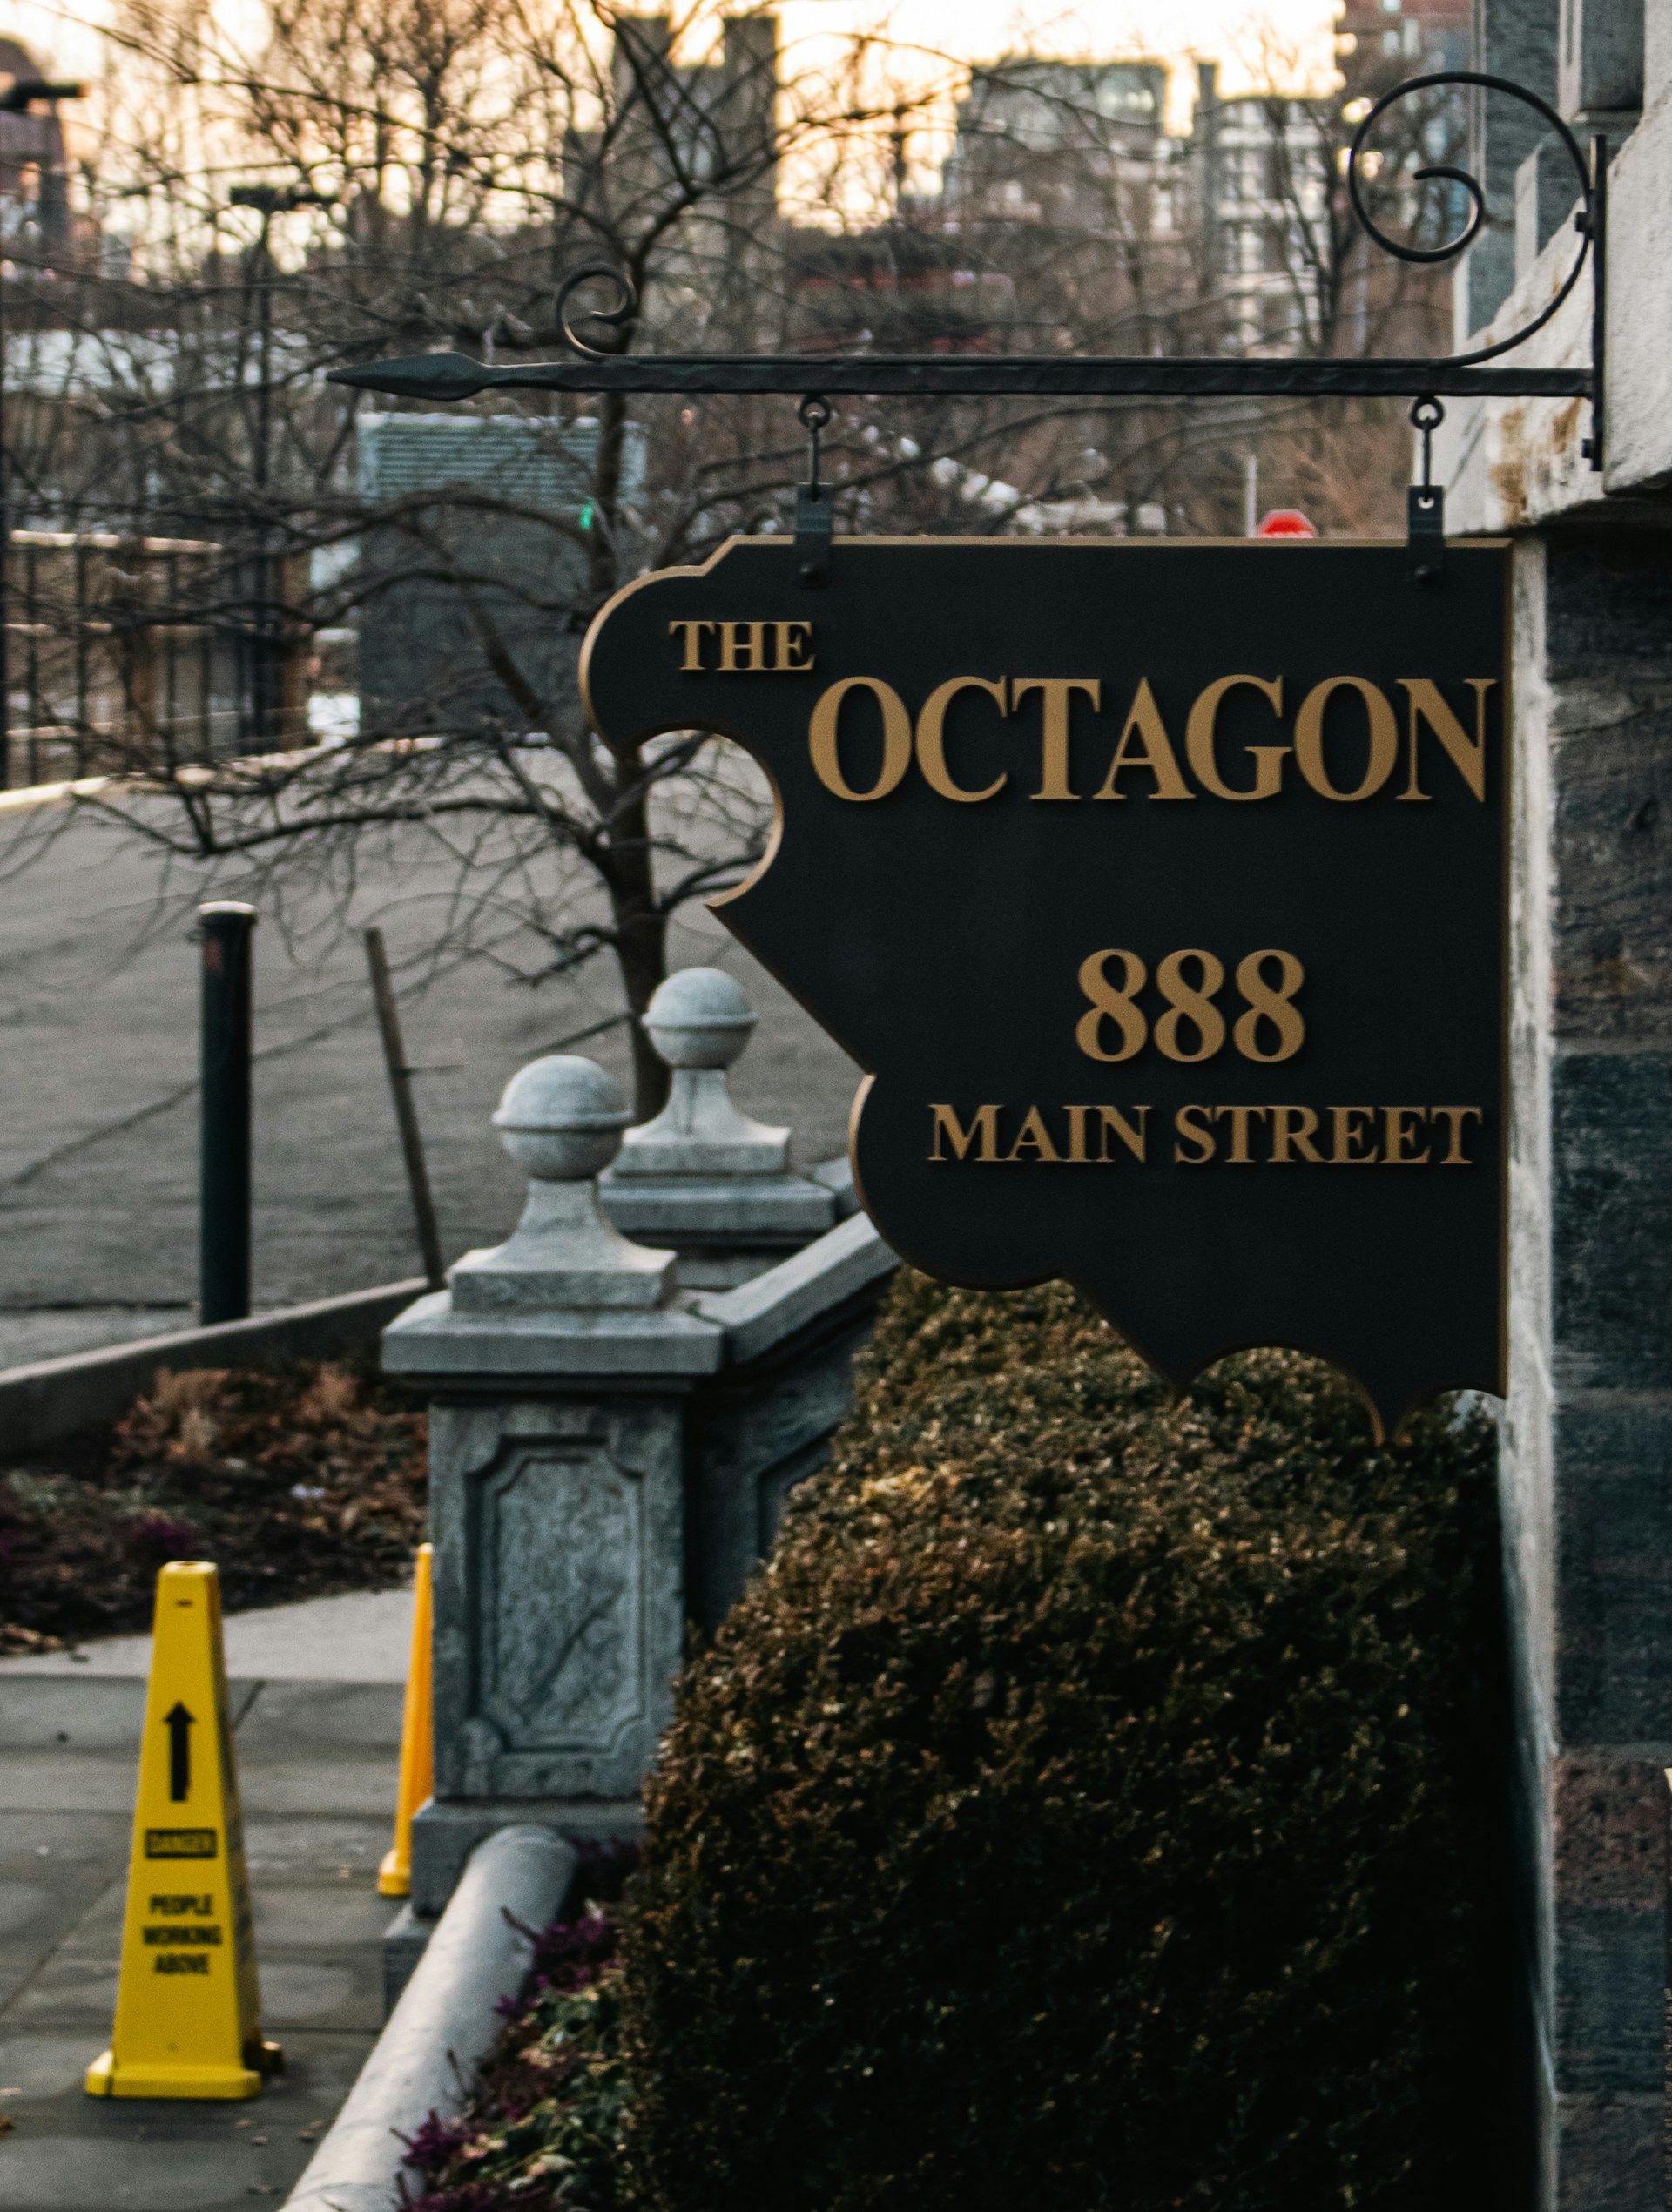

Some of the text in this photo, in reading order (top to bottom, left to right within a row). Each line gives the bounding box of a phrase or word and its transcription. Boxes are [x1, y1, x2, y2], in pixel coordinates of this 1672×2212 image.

[668, 619, 816, 671] THE
[807, 674, 1497, 803] OCTAGON
[1075, 948, 1306, 1063] 888
[927, 1103, 1483, 1165] MAIN STREET
[149, 1833, 215, 1854] DANGER
[150, 1895, 213, 1916] PEOPLE
[154, 1954, 209, 1975] ABOVE
